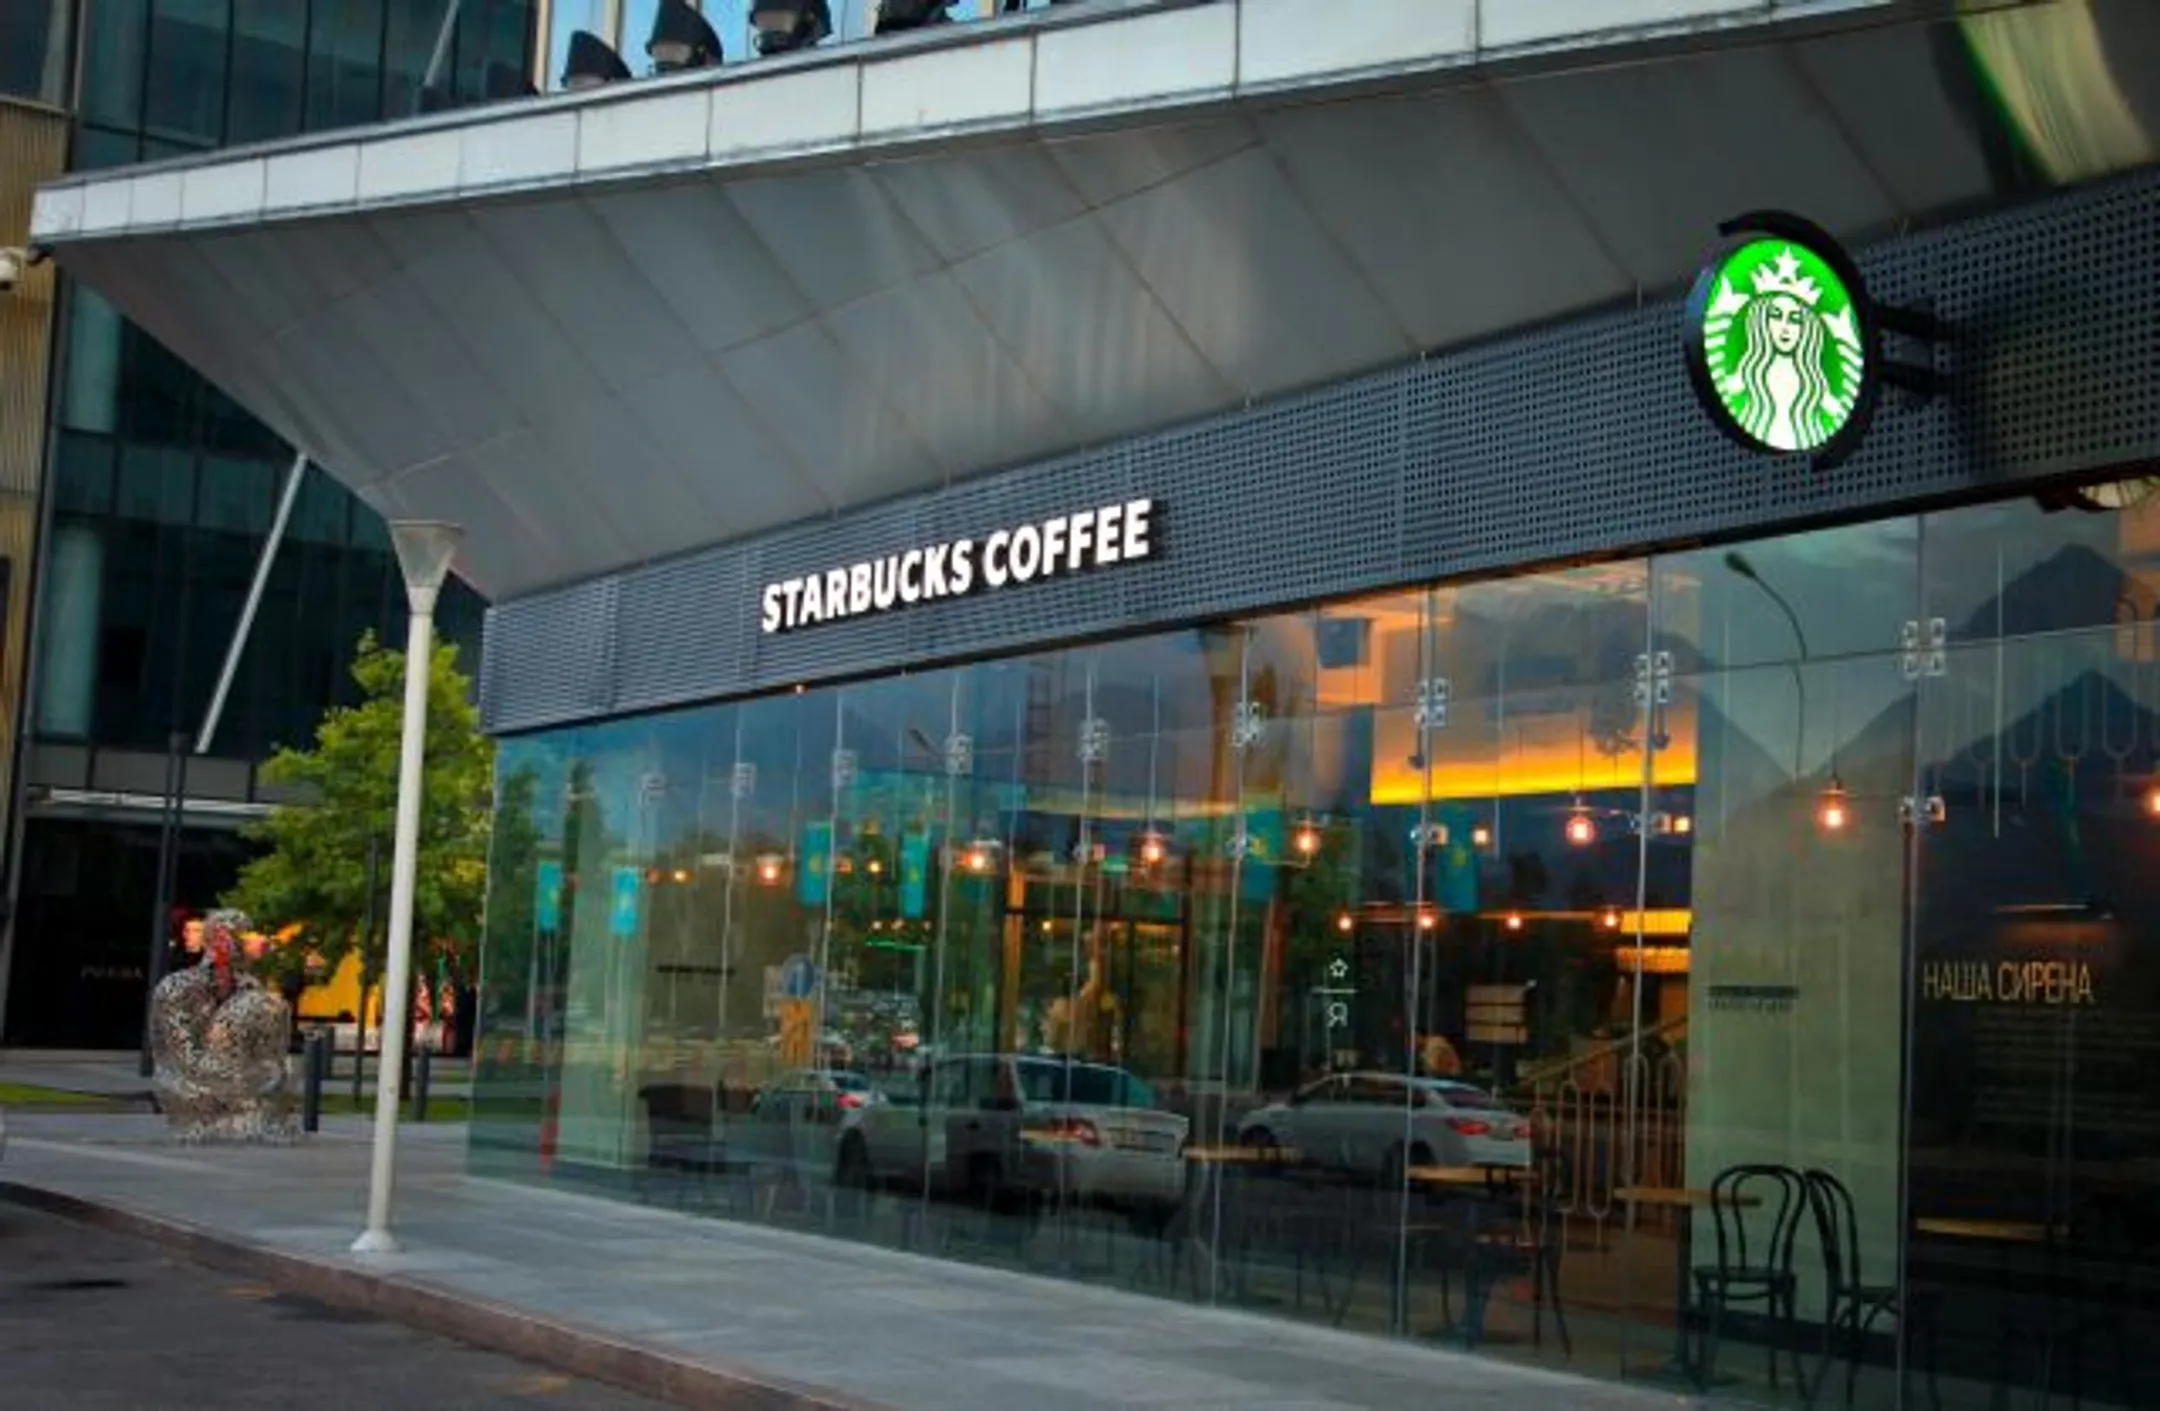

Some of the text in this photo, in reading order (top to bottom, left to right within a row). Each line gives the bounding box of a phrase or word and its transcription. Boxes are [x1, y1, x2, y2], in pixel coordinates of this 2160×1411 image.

[761, 500, 1152, 633] STARBUCKS COFFEE
[1922, 960, 2095, 1004] НАША СИРЕНА
